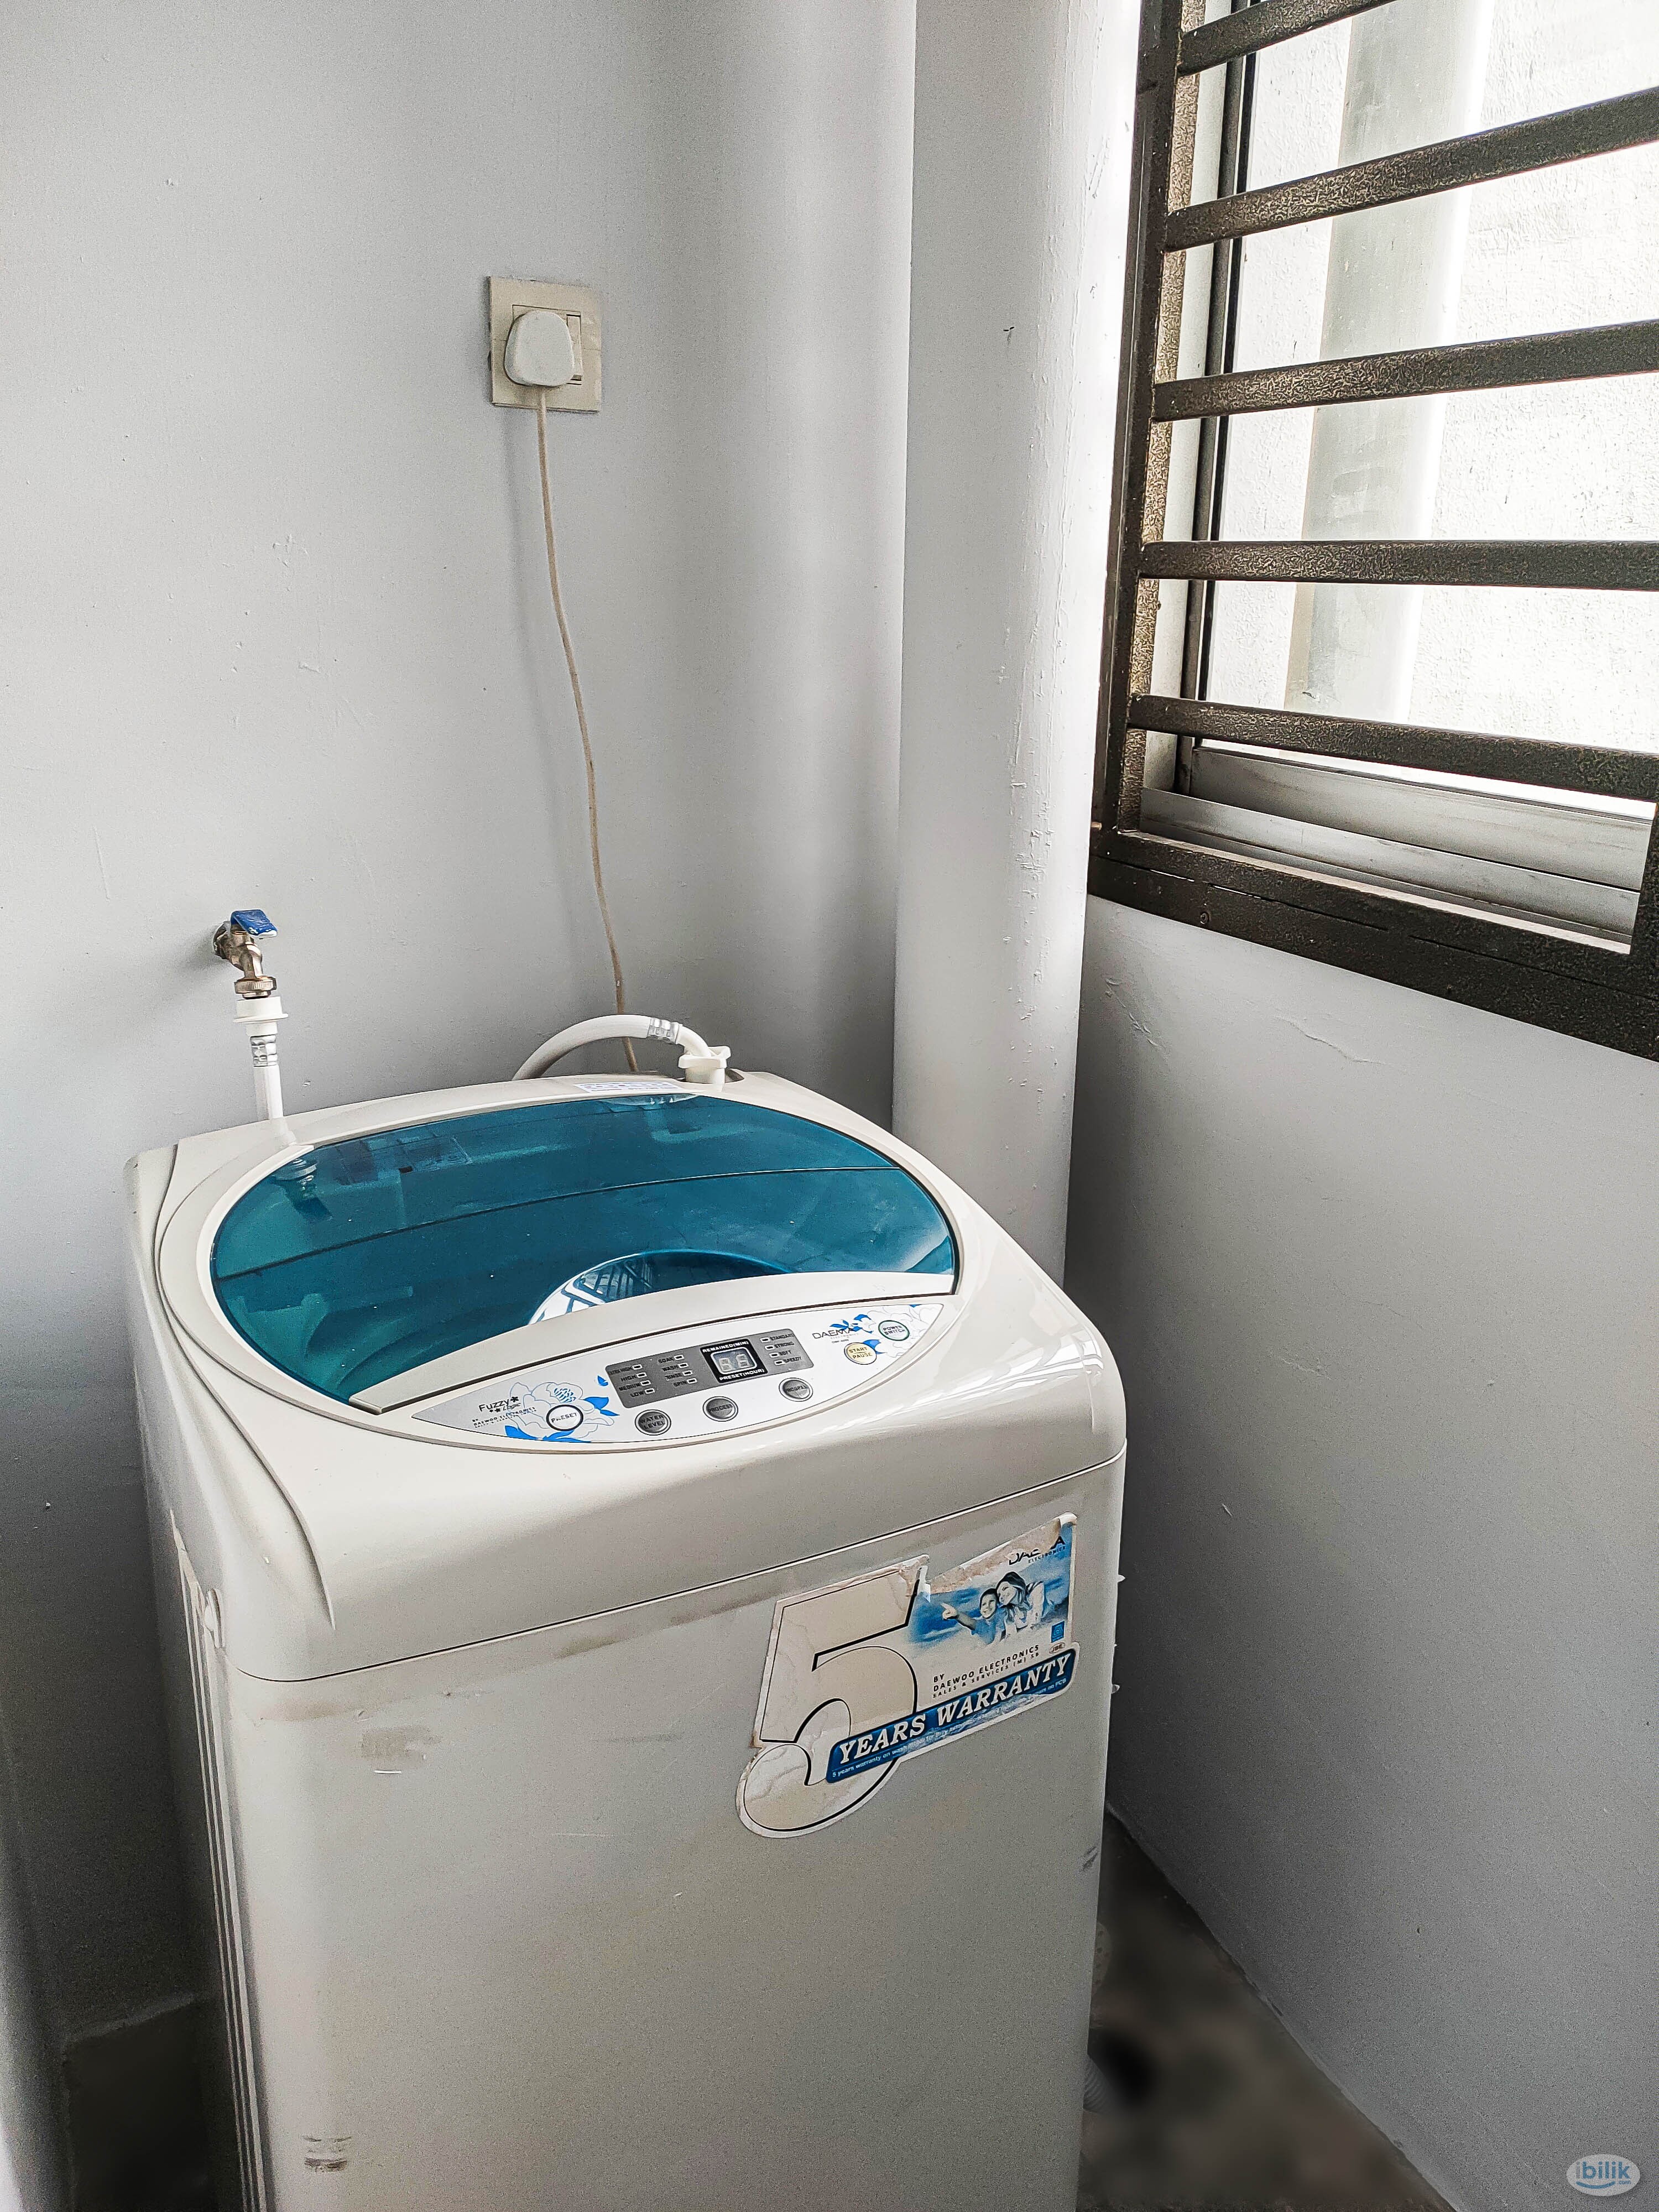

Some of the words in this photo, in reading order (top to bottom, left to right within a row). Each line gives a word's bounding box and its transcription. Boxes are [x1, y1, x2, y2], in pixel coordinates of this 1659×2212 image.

[479, 1399, 510, 1412] Fuzzy
[640, 1414, 664, 1424] WATER
[643, 1421, 665, 1430] LEVEL
[933, 1671, 974, 1692] DAEWOO
[979, 1645, 1040, 1674] ELECTRONICS
[933, 1673, 945, 1683] BY
[933, 1685, 957, 1698] SALES
[971, 1664, 1009, 1683] SERVICES
[839, 1714, 925, 1764] YEARS
[937, 1653, 1071, 1726] WARRANTY
[838, 1766, 854, 1777] years
[855, 1756, 881, 1768] warranty
